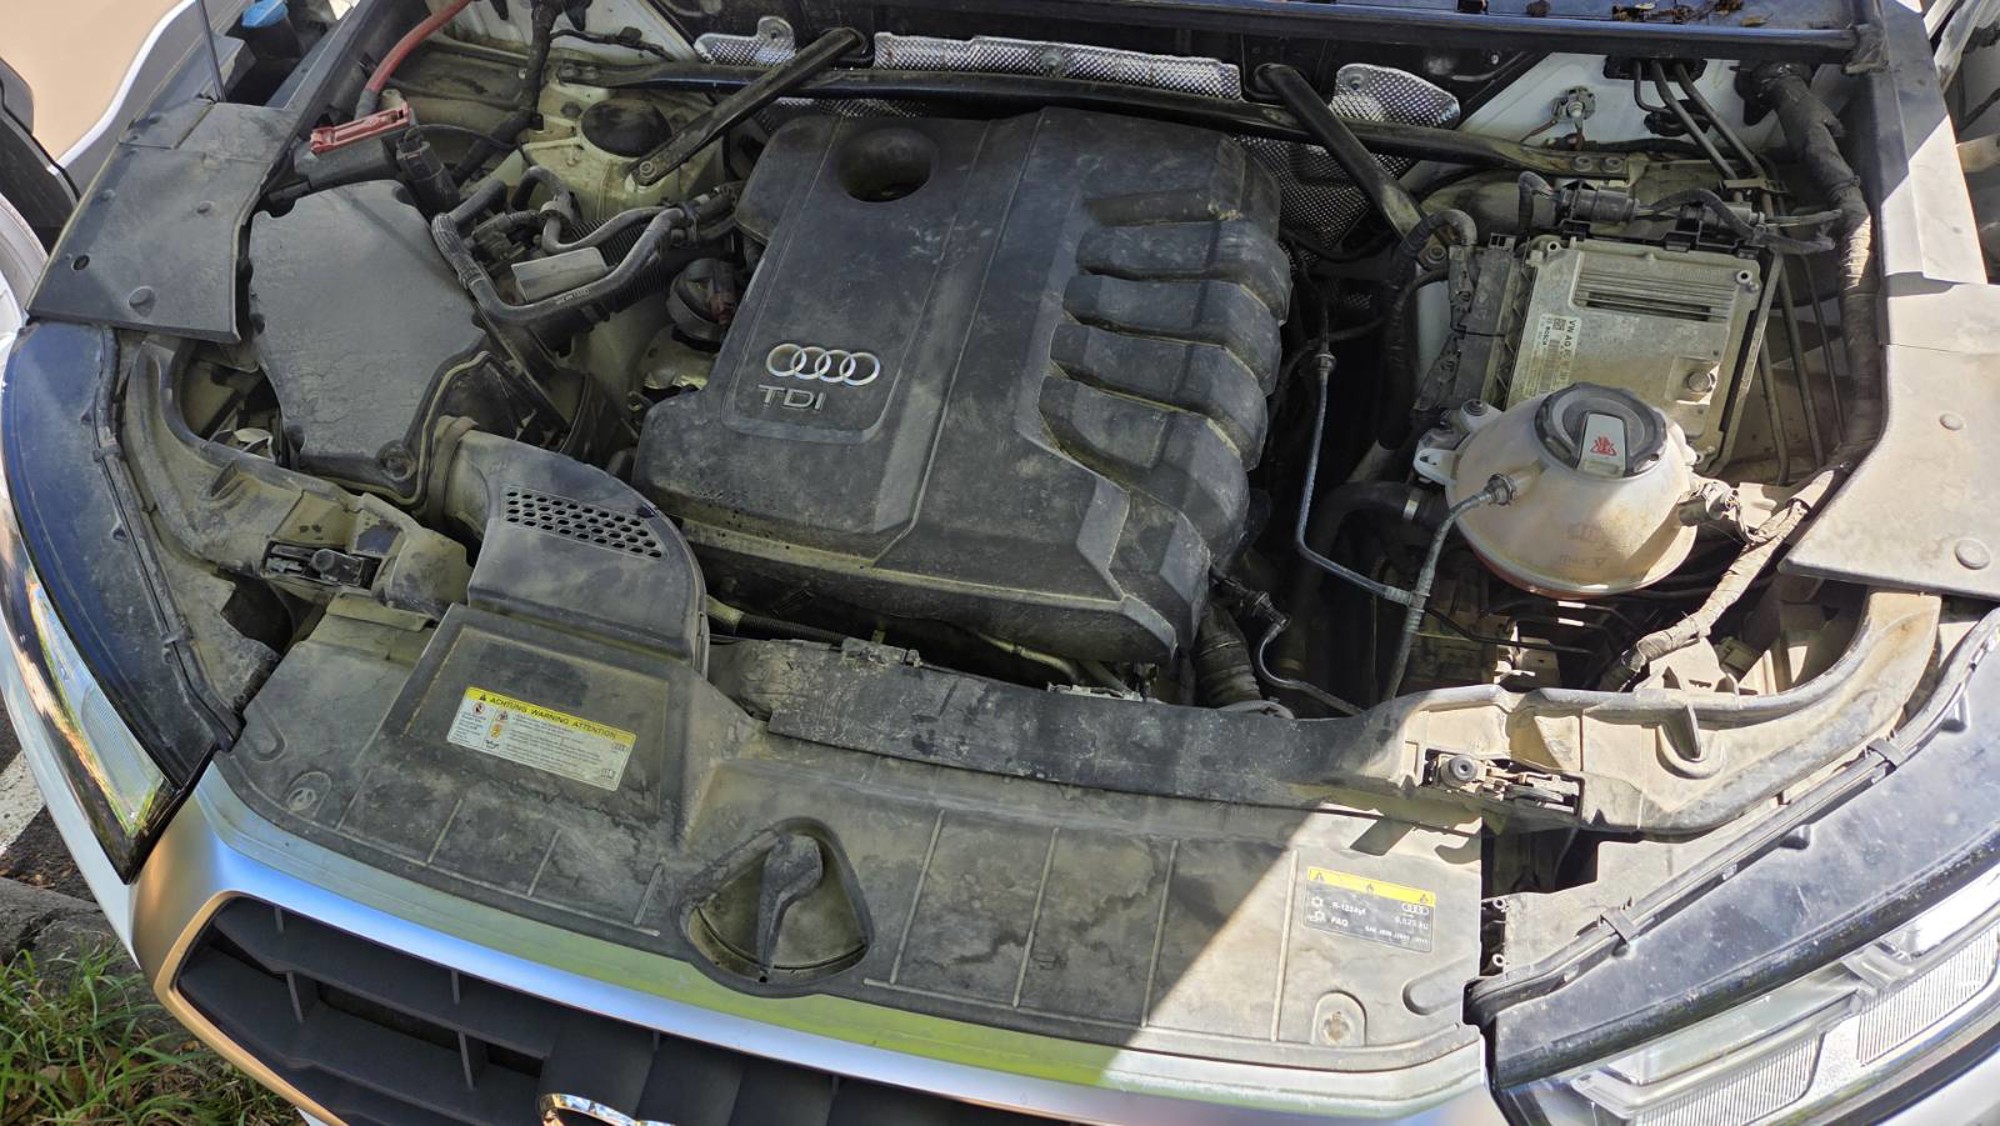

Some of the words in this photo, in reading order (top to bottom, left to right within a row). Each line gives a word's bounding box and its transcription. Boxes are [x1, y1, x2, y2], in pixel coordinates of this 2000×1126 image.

[758, 384, 826, 411] TDI
[489, 697, 527, 713] ACHTUNG
[531, 709, 569, 725] WARNING
[573, 720, 616, 739] ATTENTION
